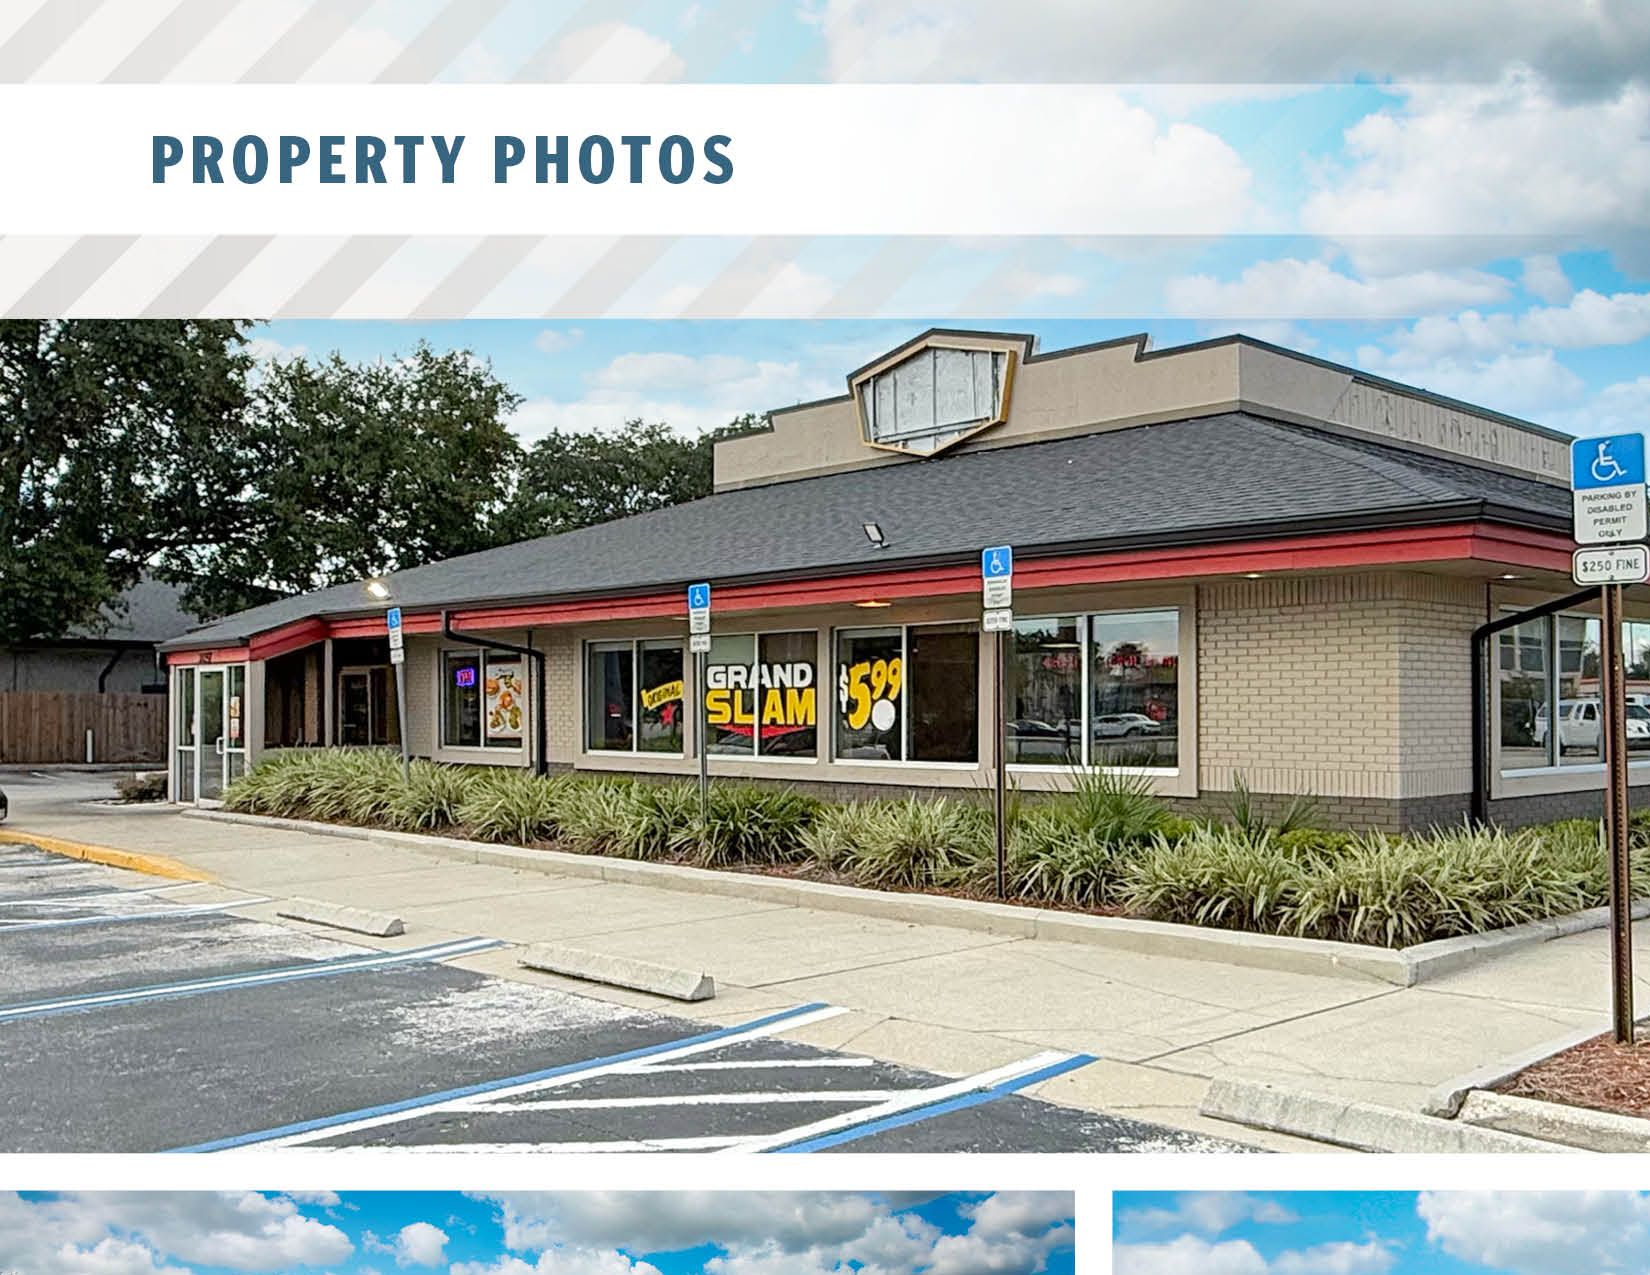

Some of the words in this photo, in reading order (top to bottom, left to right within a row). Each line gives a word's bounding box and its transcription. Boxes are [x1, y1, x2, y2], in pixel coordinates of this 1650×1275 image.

[1581, 492, 1622, 502] PARKING
[1625, 490, 1637, 498] BY
[1587, 503, 1633, 514] DISABLED
[1593, 516, 1627, 526] PERMIT
[1598, 528, 1623, 538] ONLY
[1582, 559, 1612, 573] $250
[1616, 557, 1640, 571] FINE
[707, 662, 813, 690] GRAND
[706, 687, 816, 726] SLAM
